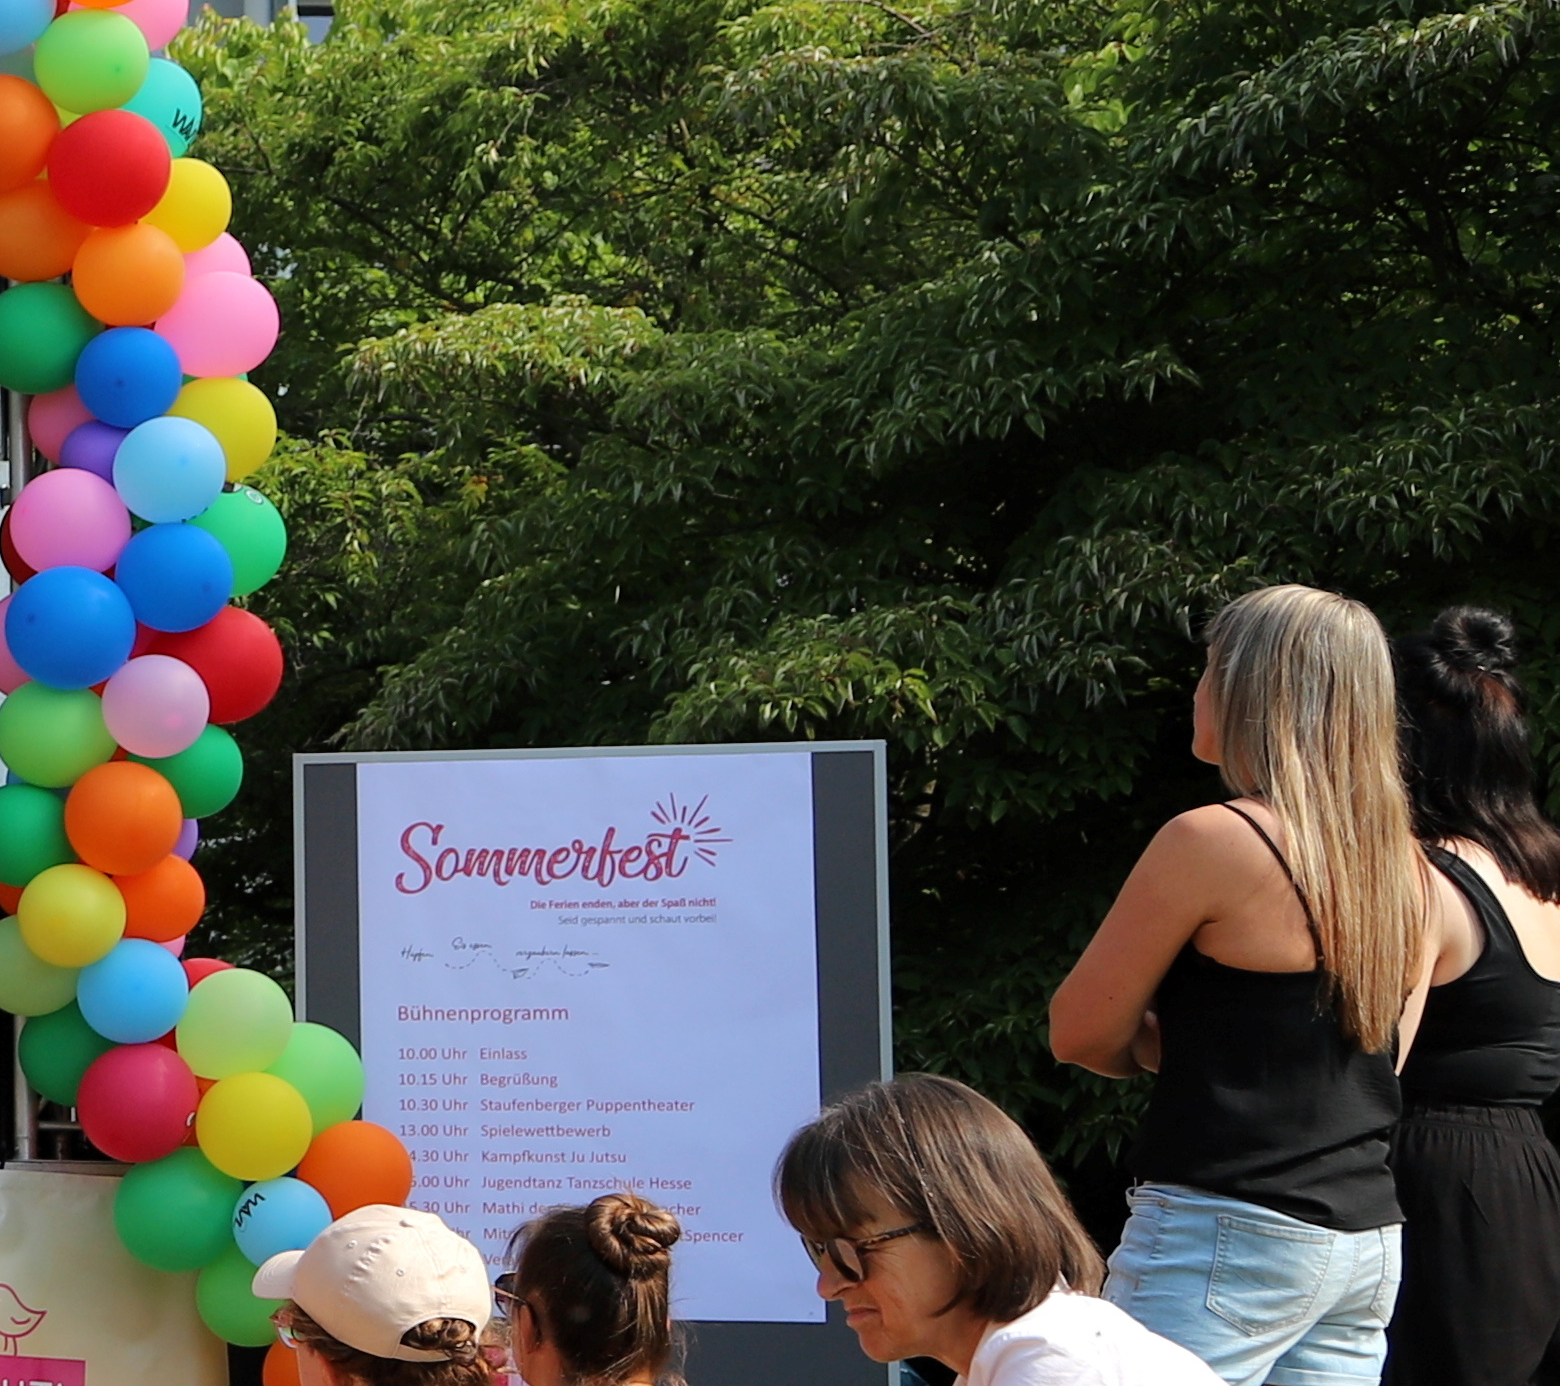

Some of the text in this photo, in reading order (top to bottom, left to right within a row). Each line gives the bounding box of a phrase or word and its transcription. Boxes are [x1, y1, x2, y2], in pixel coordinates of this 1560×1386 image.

[395, 821, 691, 894] Sommerfest
[530, 898, 546, 909] Die
[548, 897, 580, 909] Ferien
[618, 897, 640, 908] aber
[642, 897, 659, 908] der
[661, 897, 686, 910] Spaß
[688, 897, 717, 908] nicht!
[558, 912, 717, 928] Seid gespannt und schaut vorbei!
[397, 1005, 569, 1024] Bühnenprogramm
[398, 1047, 528, 1060] 10.00 Uhr Einlass
[398, 1073, 558, 1088] 10.15 Uhr Begrüßung
[399, 1098, 695, 1114] 10.30 Uhr Staufenberger Puppentheater
[399, 1124, 611, 1140] 13.00 Uhr Spielewettbewerb
[442, 1150, 469, 1163] Uhr
[481, 1150, 566, 1165] Kampfkunst
[570, 1151, 585, 1164] Ju
[589, 1151, 627, 1164] Jutsu
[443, 1176, 469, 1189] Uhr
[481, 1176, 562, 1192] Jugendtanz
[567, 1176, 645, 1190] Tanzschule
[649, 1177, 692, 1190] Hesse
[443, 1202, 469, 1214] Uhr
[482, 1202, 525, 1215] Mathi
